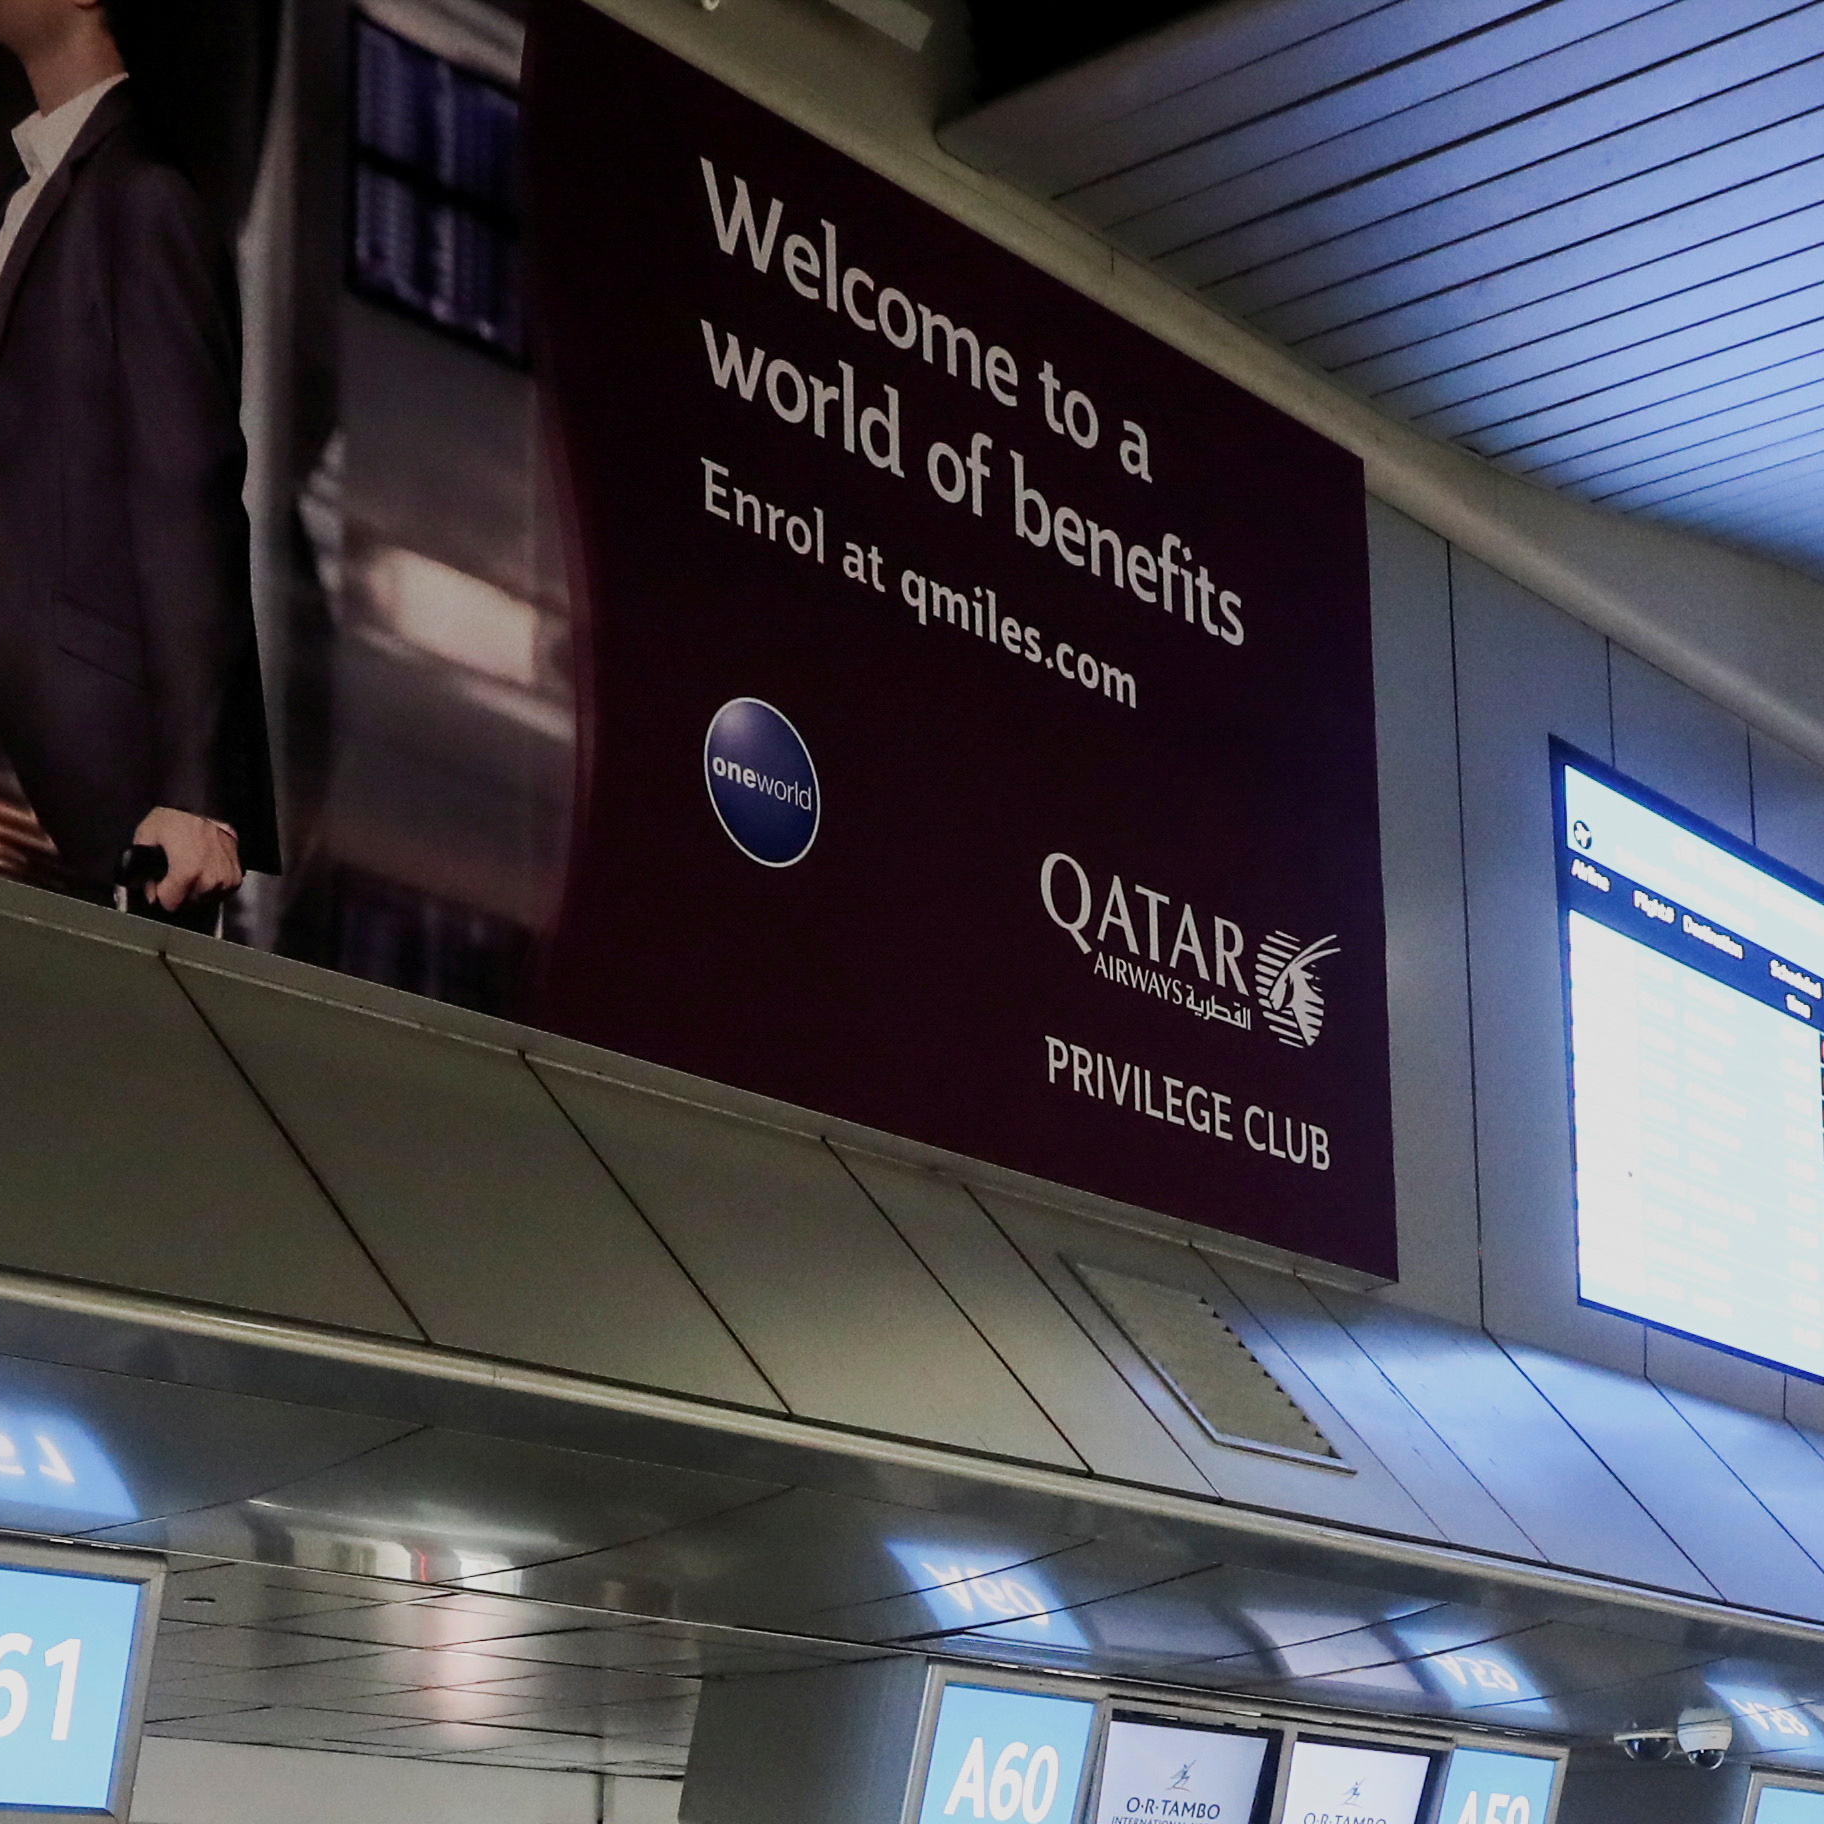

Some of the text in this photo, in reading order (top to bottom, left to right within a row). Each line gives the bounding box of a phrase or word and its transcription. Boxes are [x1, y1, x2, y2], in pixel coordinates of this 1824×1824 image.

[701, 156, 1153, 483] Welcome to a
[701, 319, 1244, 646] world of benefits
[701, 457, 1137, 708] Enrol at qmiles.com
[713, 755, 812, 811] oneworld
[1041, 853, 1249, 996] QATAR
[1094, 951, 1182, 1005] AIRWAYS
[1045, 1035, 1330, 1170] PRIVILEGE CLUB
[943, 1736, 1059, 1824] A60
